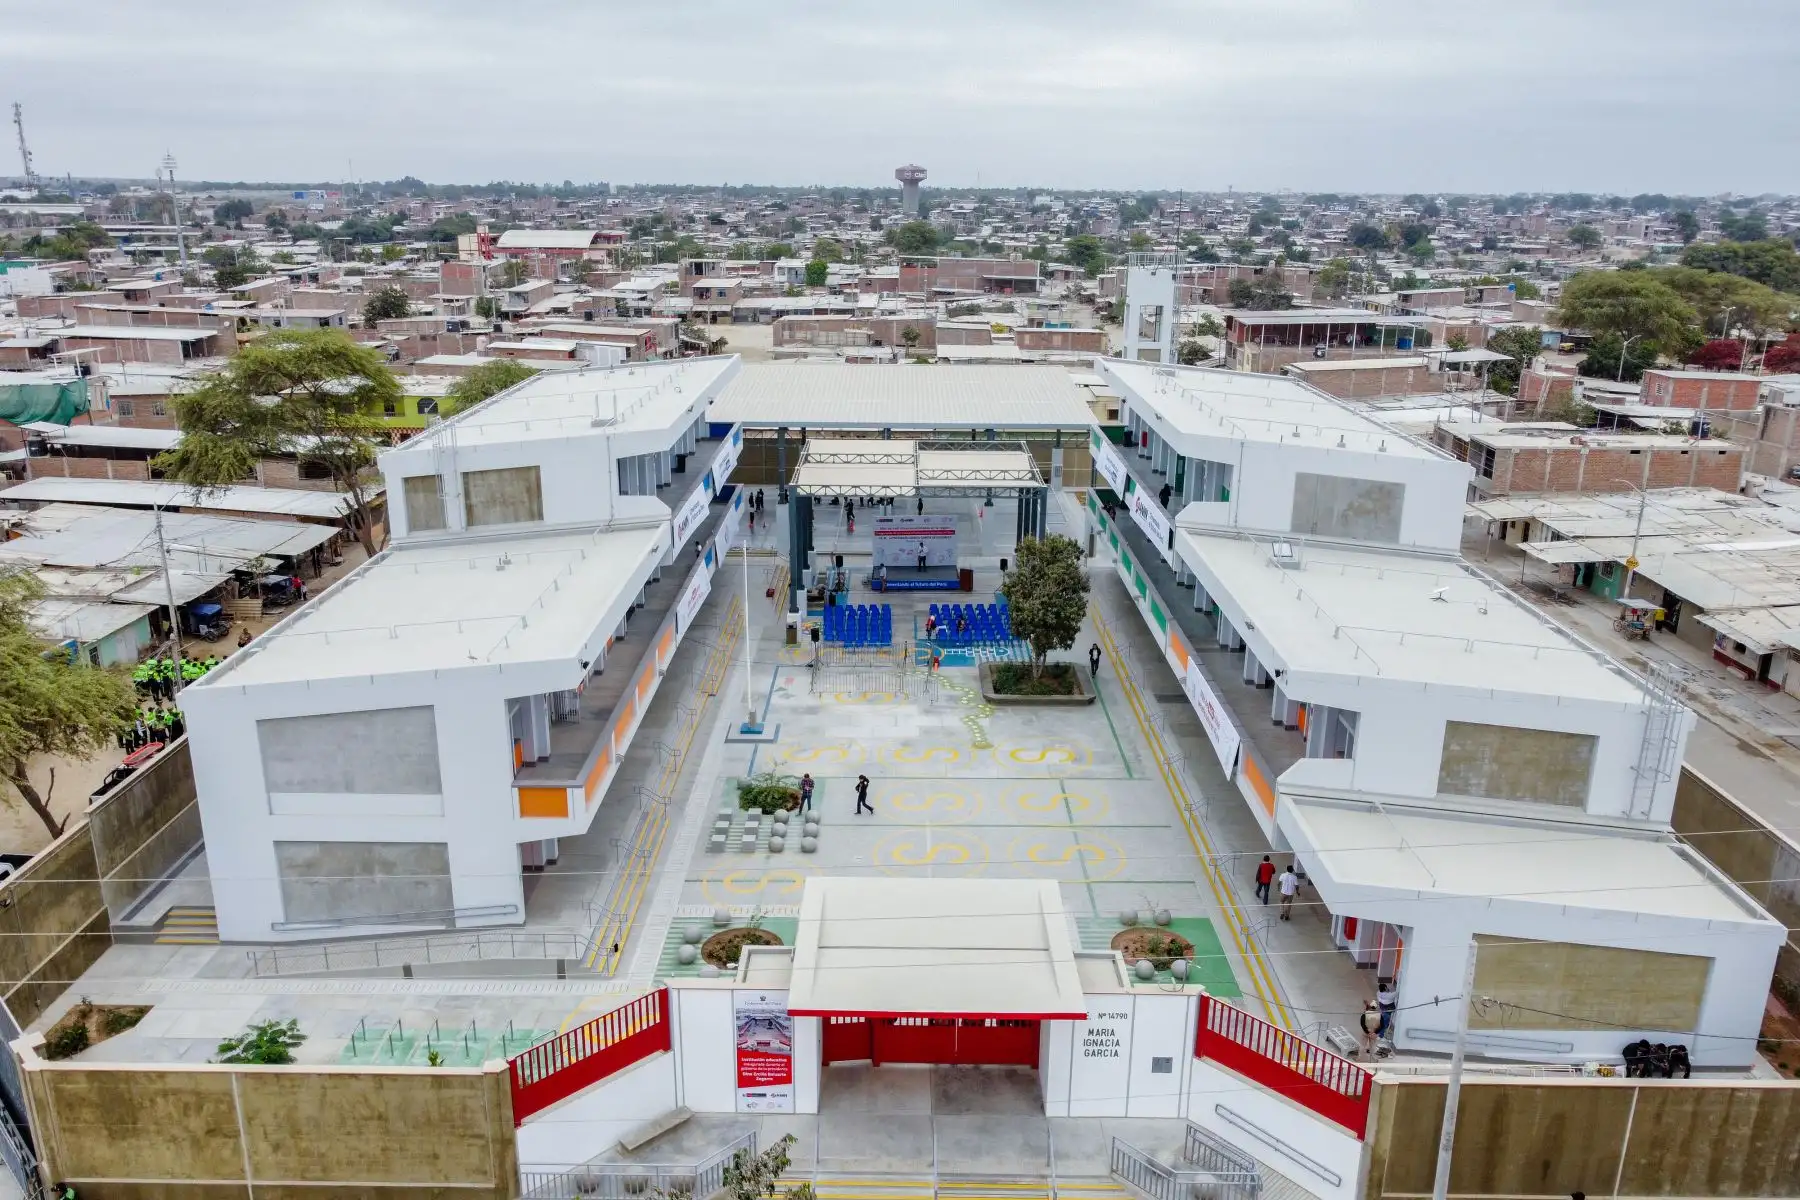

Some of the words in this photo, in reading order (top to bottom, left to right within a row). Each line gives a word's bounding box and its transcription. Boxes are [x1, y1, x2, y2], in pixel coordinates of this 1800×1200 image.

[783, 746, 848, 761] S
[894, 746, 959, 762] S
[1009, 746, 1075, 762] S
[892, 792, 966, 811] S
[1017, 793, 1090, 811] S
[892, 844, 970, 864] S
[1028, 844, 1106, 864] S
[1108, 1012, 1128, 1020] 14790
[1087, 1028, 1115, 1037] MARIA
[1083, 1038, 1121, 1047] IGNACIA
[1084, 1048, 1119, 1058] GARCIA
